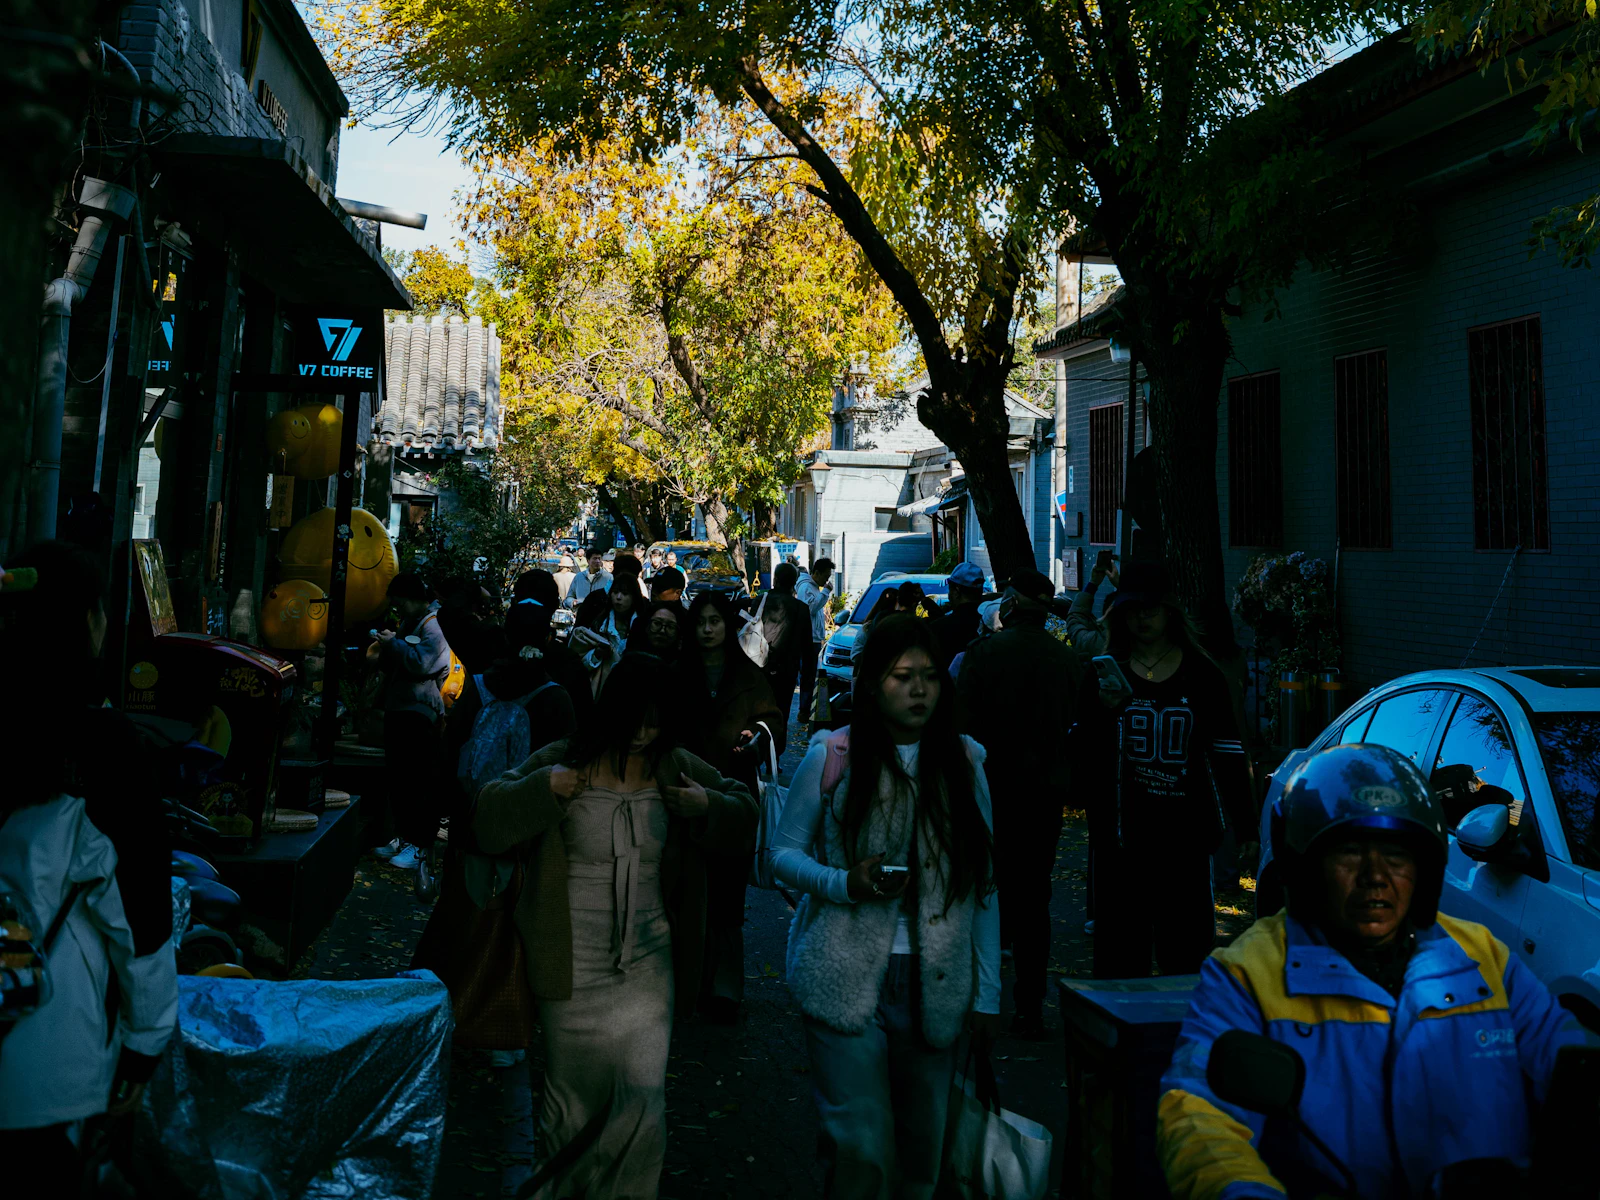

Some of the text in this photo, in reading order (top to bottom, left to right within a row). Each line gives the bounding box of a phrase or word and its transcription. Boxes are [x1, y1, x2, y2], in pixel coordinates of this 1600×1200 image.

[298, 364, 374, 379] V7 COFFEE
[128, 690, 156, 703] 小豚
[1125, 706, 1194, 764] 90
